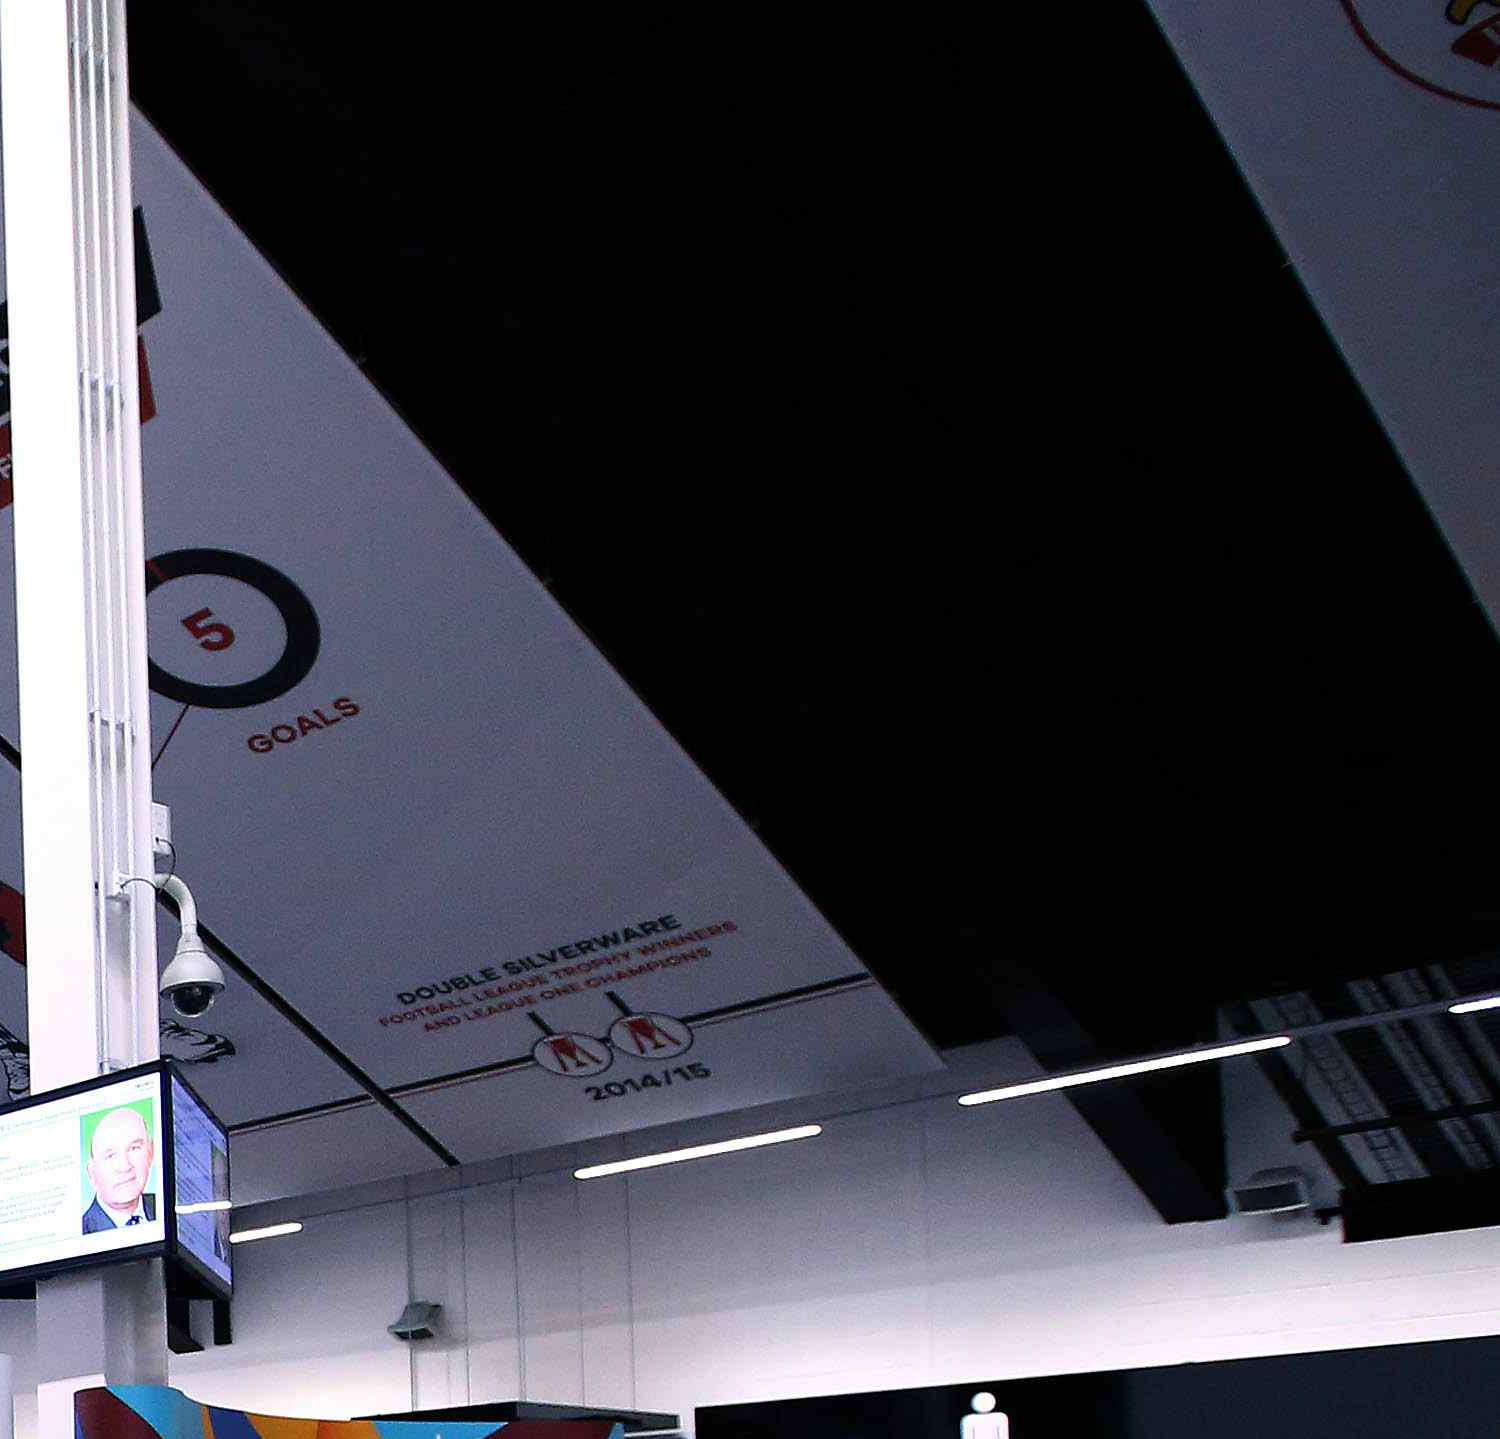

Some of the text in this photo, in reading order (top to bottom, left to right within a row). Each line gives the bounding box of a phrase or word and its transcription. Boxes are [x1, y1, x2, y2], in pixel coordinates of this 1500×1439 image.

[181, 607, 235, 651] 5
[248, 697, 360, 752] GOALS
[379, 920, 739, 1027] FOOTBALL LEAGUE TROPHY WINNERS
[397, 915, 683, 1006] DOUBLE SILVERWARE
[424, 946, 713, 1033] AND LEAGUE ONE CHAMPIONS
[585, 1062, 713, 1102] 2014/15
